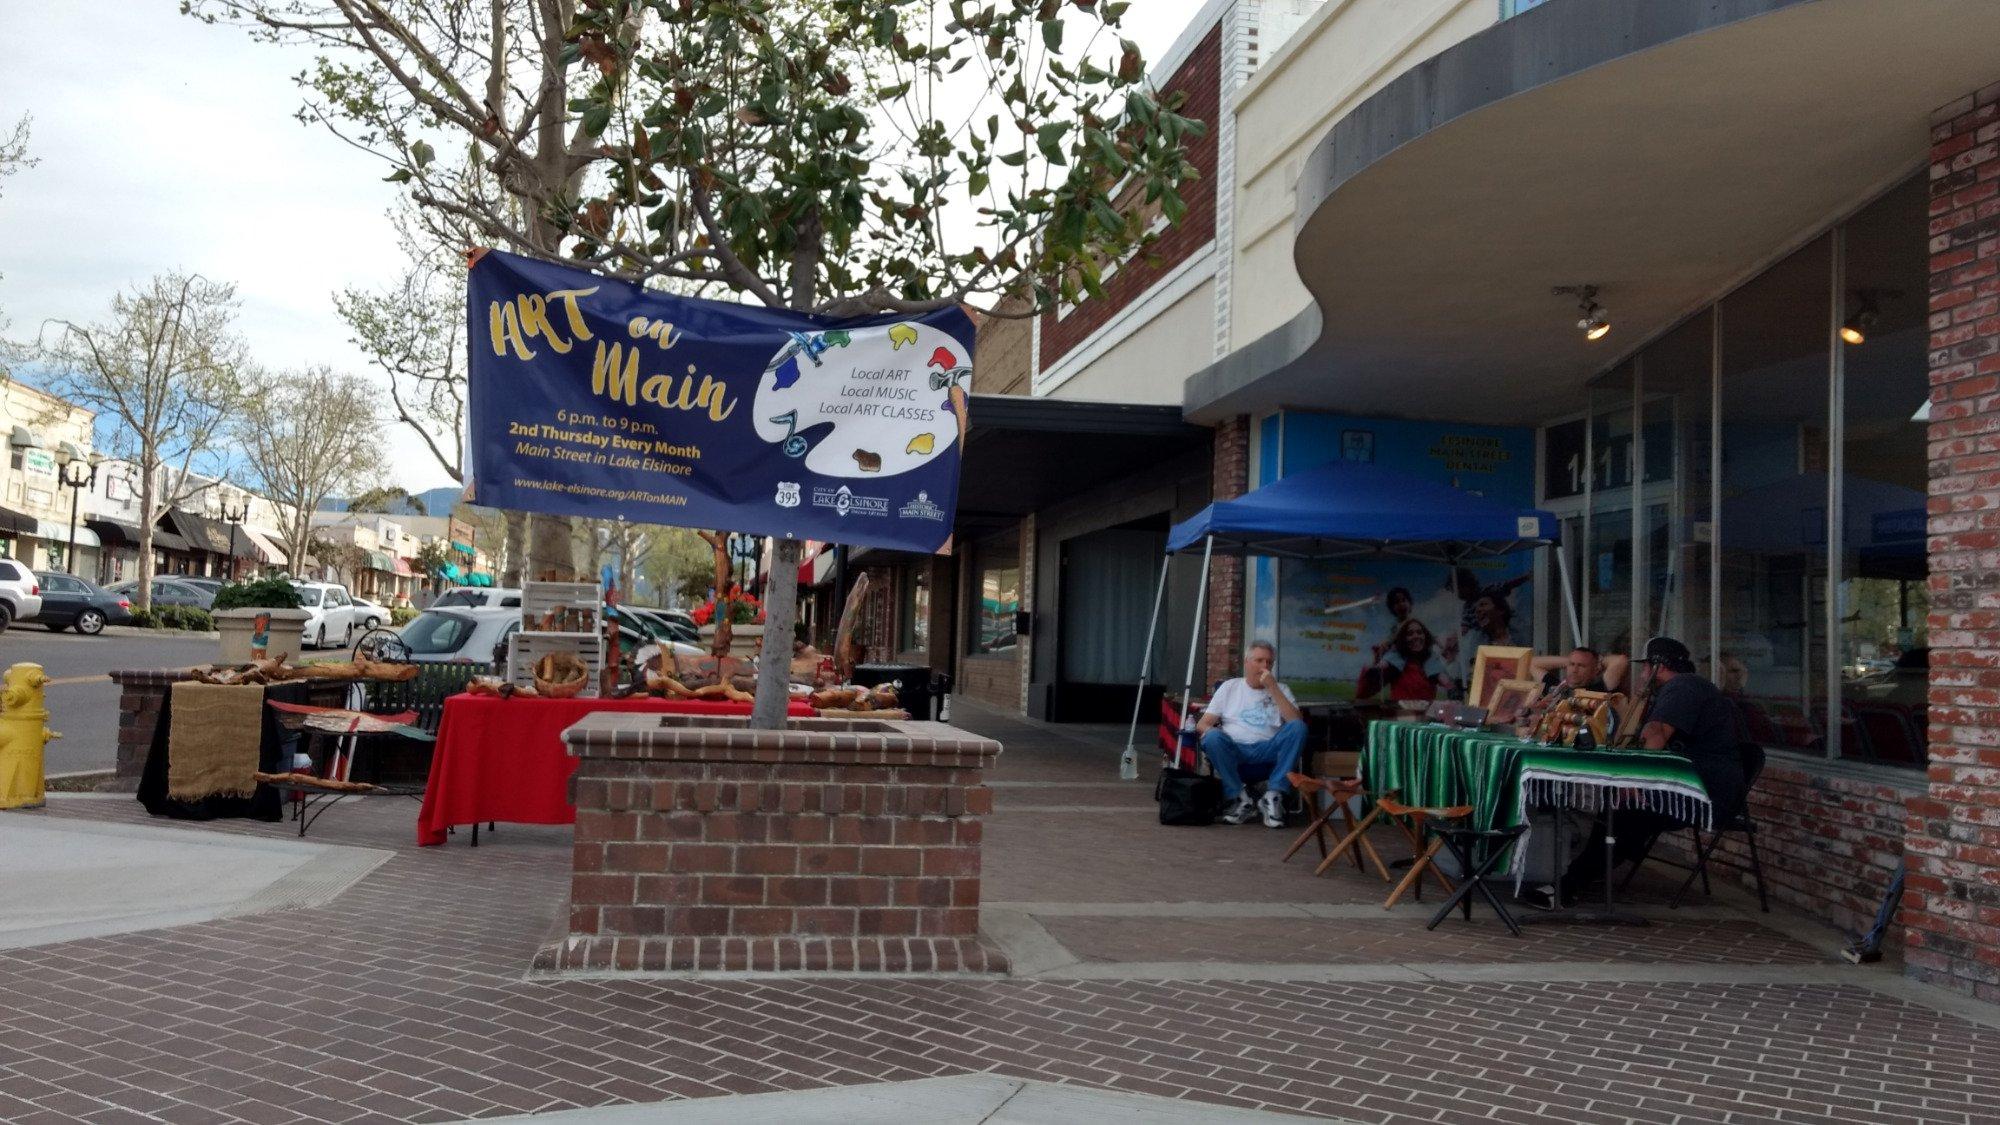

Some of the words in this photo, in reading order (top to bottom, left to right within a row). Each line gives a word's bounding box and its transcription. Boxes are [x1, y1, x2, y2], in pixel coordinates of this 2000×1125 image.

[490, 286, 599, 361] ART
[628, 316, 682, 350] on
[592, 340, 738, 422] Main
[851, 367, 885, 380] Local
[884, 369, 911, 381] ART
[841, 385, 874, 398] Local
[876, 387, 918, 401] MUSIC
[557, 409, 566, 422] 6
[570, 412, 599, 426] p.m.
[602, 415, 616, 429] to
[620, 416, 629, 429] 9
[632, 422, 659, 436] p.m.
[820, 402, 852, 414] Local
[853, 404, 880, 416] ART
[881, 405, 935, 421] CLASSES
[510, 421, 538, 437] 2nd
[541, 424, 609, 448] Thursday
[613, 434, 651, 453] Every
[655, 442, 701, 459] Month
[515, 441, 549, 458] Main
[553, 446, 591, 463] Street
[594, 451, 606, 464] in
[609, 454, 640, 469] Lake
[643, 457, 692, 476] Elsinore
[514, 478, 687, 506] www.lake-elsinore.org/ARTonMAIN
[778, 491, 798, 505] 395
[813, 494, 836, 505] LAKE
